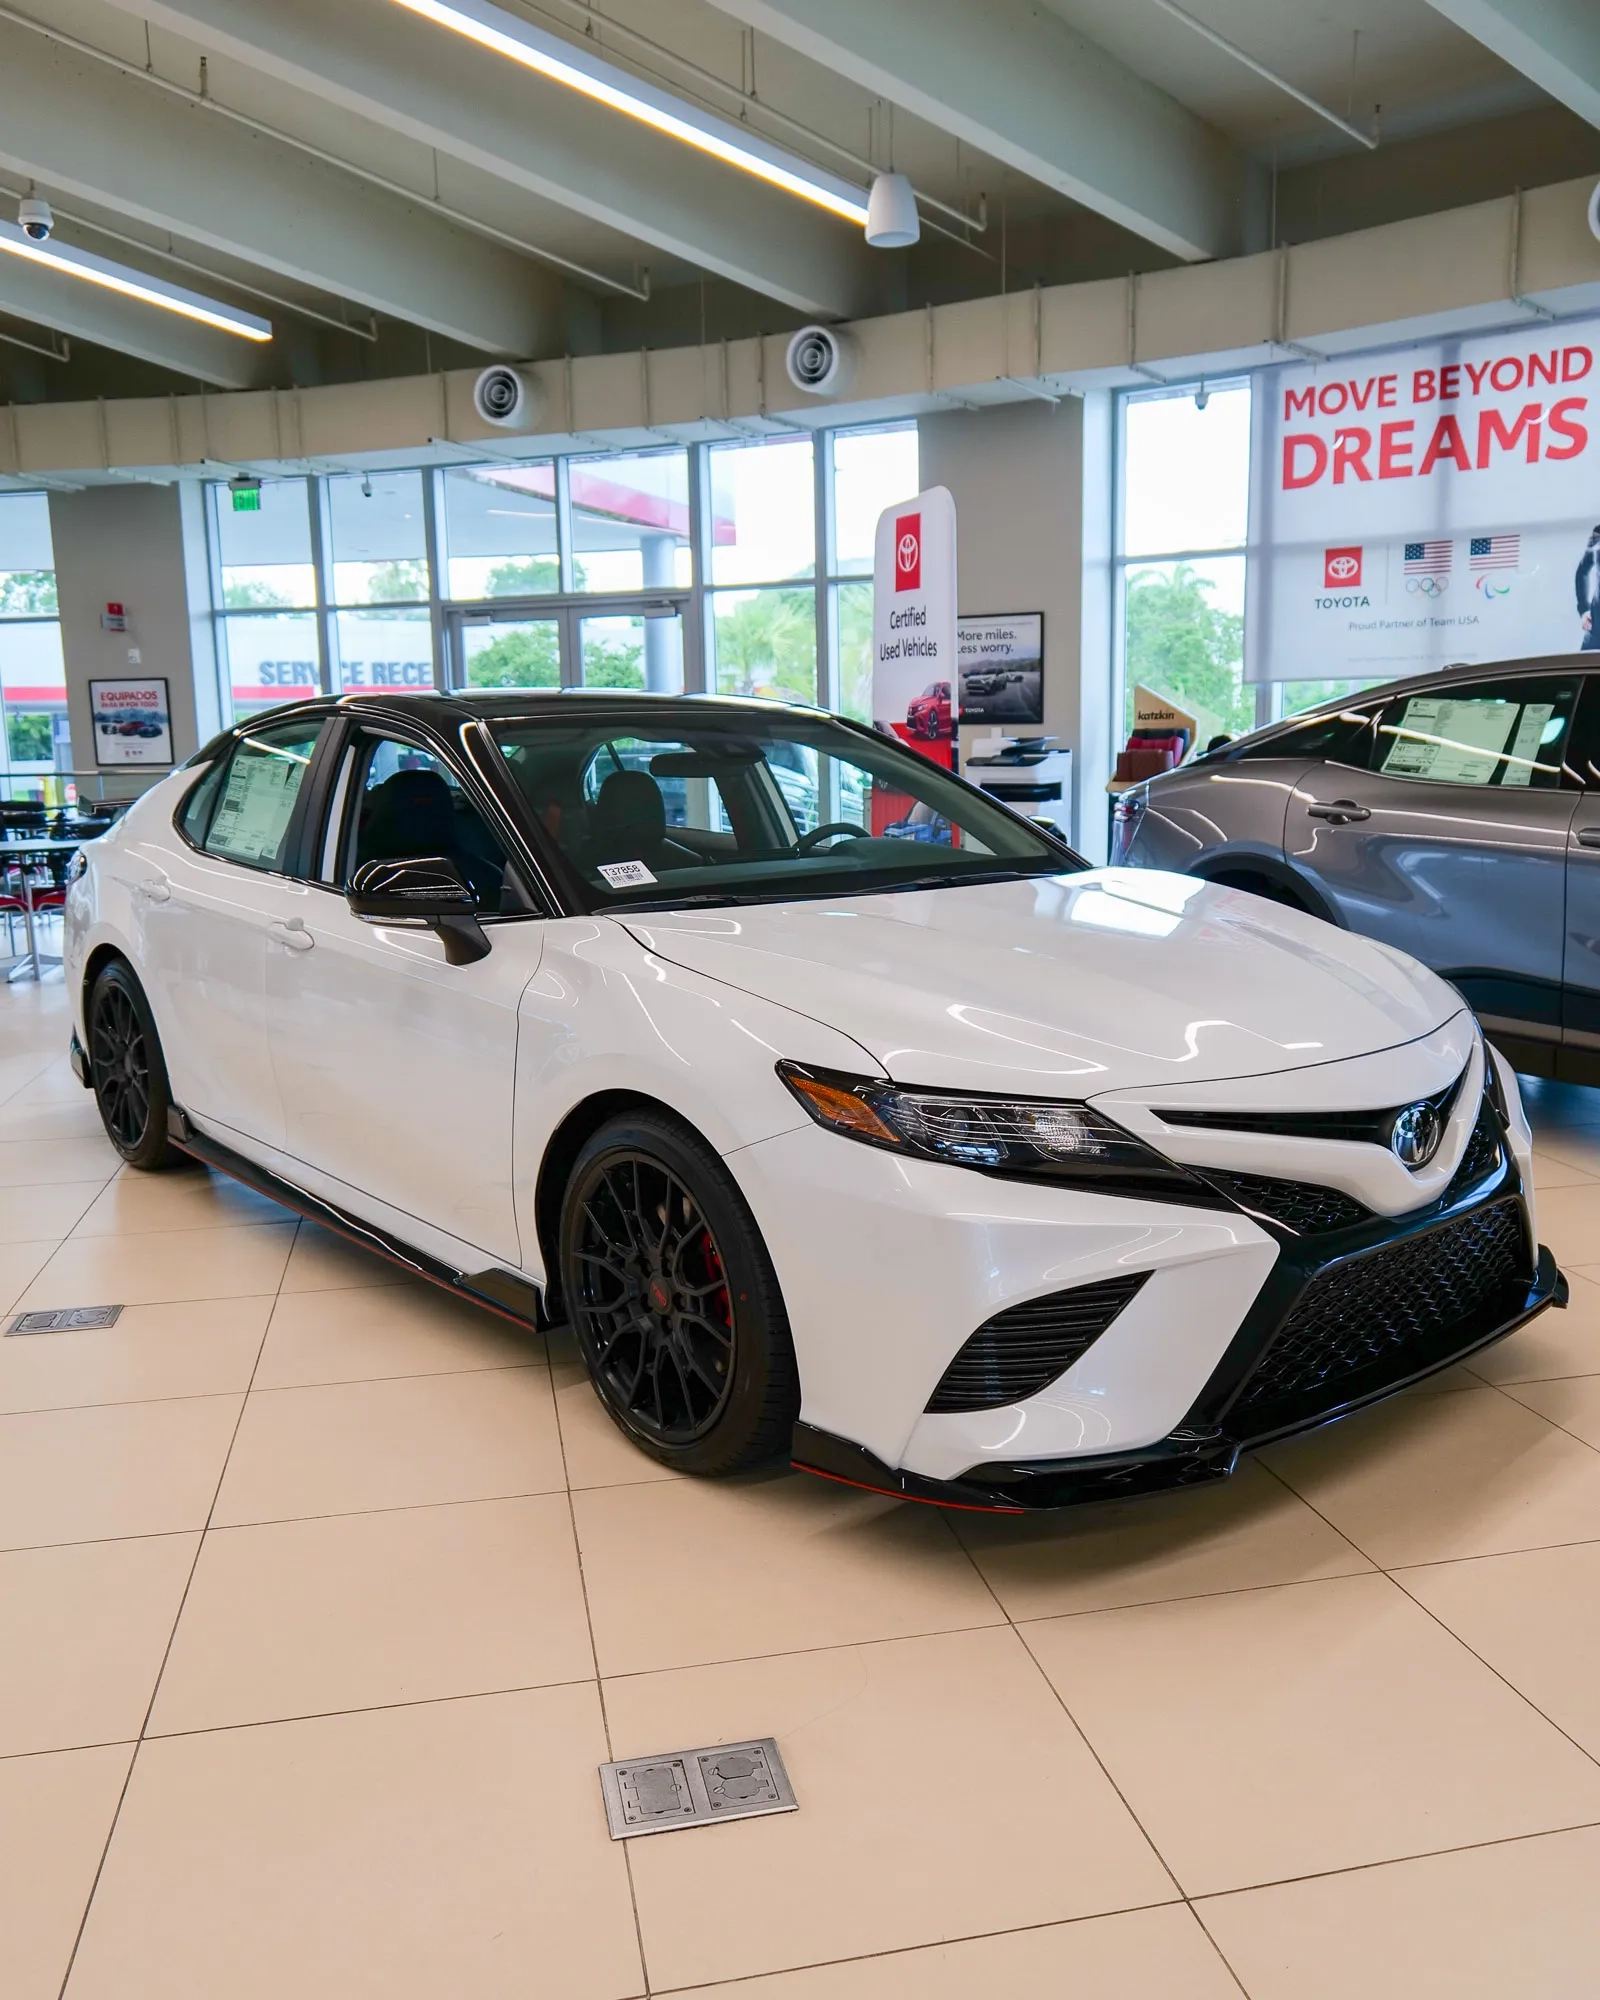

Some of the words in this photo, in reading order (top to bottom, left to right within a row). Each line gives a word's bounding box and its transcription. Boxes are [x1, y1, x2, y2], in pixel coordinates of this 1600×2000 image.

[1284, 375, 1398, 421] MOVE
[1412, 346, 1593, 404] BEYOND
[1282, 397, 1589, 490] DREAMS
[1315, 596, 1370, 609] TOYOTA
[890, 604, 927, 630] Certified
[1349, 621, 1377, 631] Proud
[1380, 619, 1414, 629] Partner
[1417, 618, 1427, 627] of
[1430, 617, 1456, 627] Team
[1458, 615, 1480, 625] USA
[985, 628, 1017, 640] miles.
[880, 638, 900, 661] Used
[902, 636, 938, 657] Vehicles
[980, 643, 1014, 655] worry.
[100, 691, 157, 701] EQUIPADOS
[1137, 709, 1175, 721] katzkin
[602, 864, 640, 876] T37858
